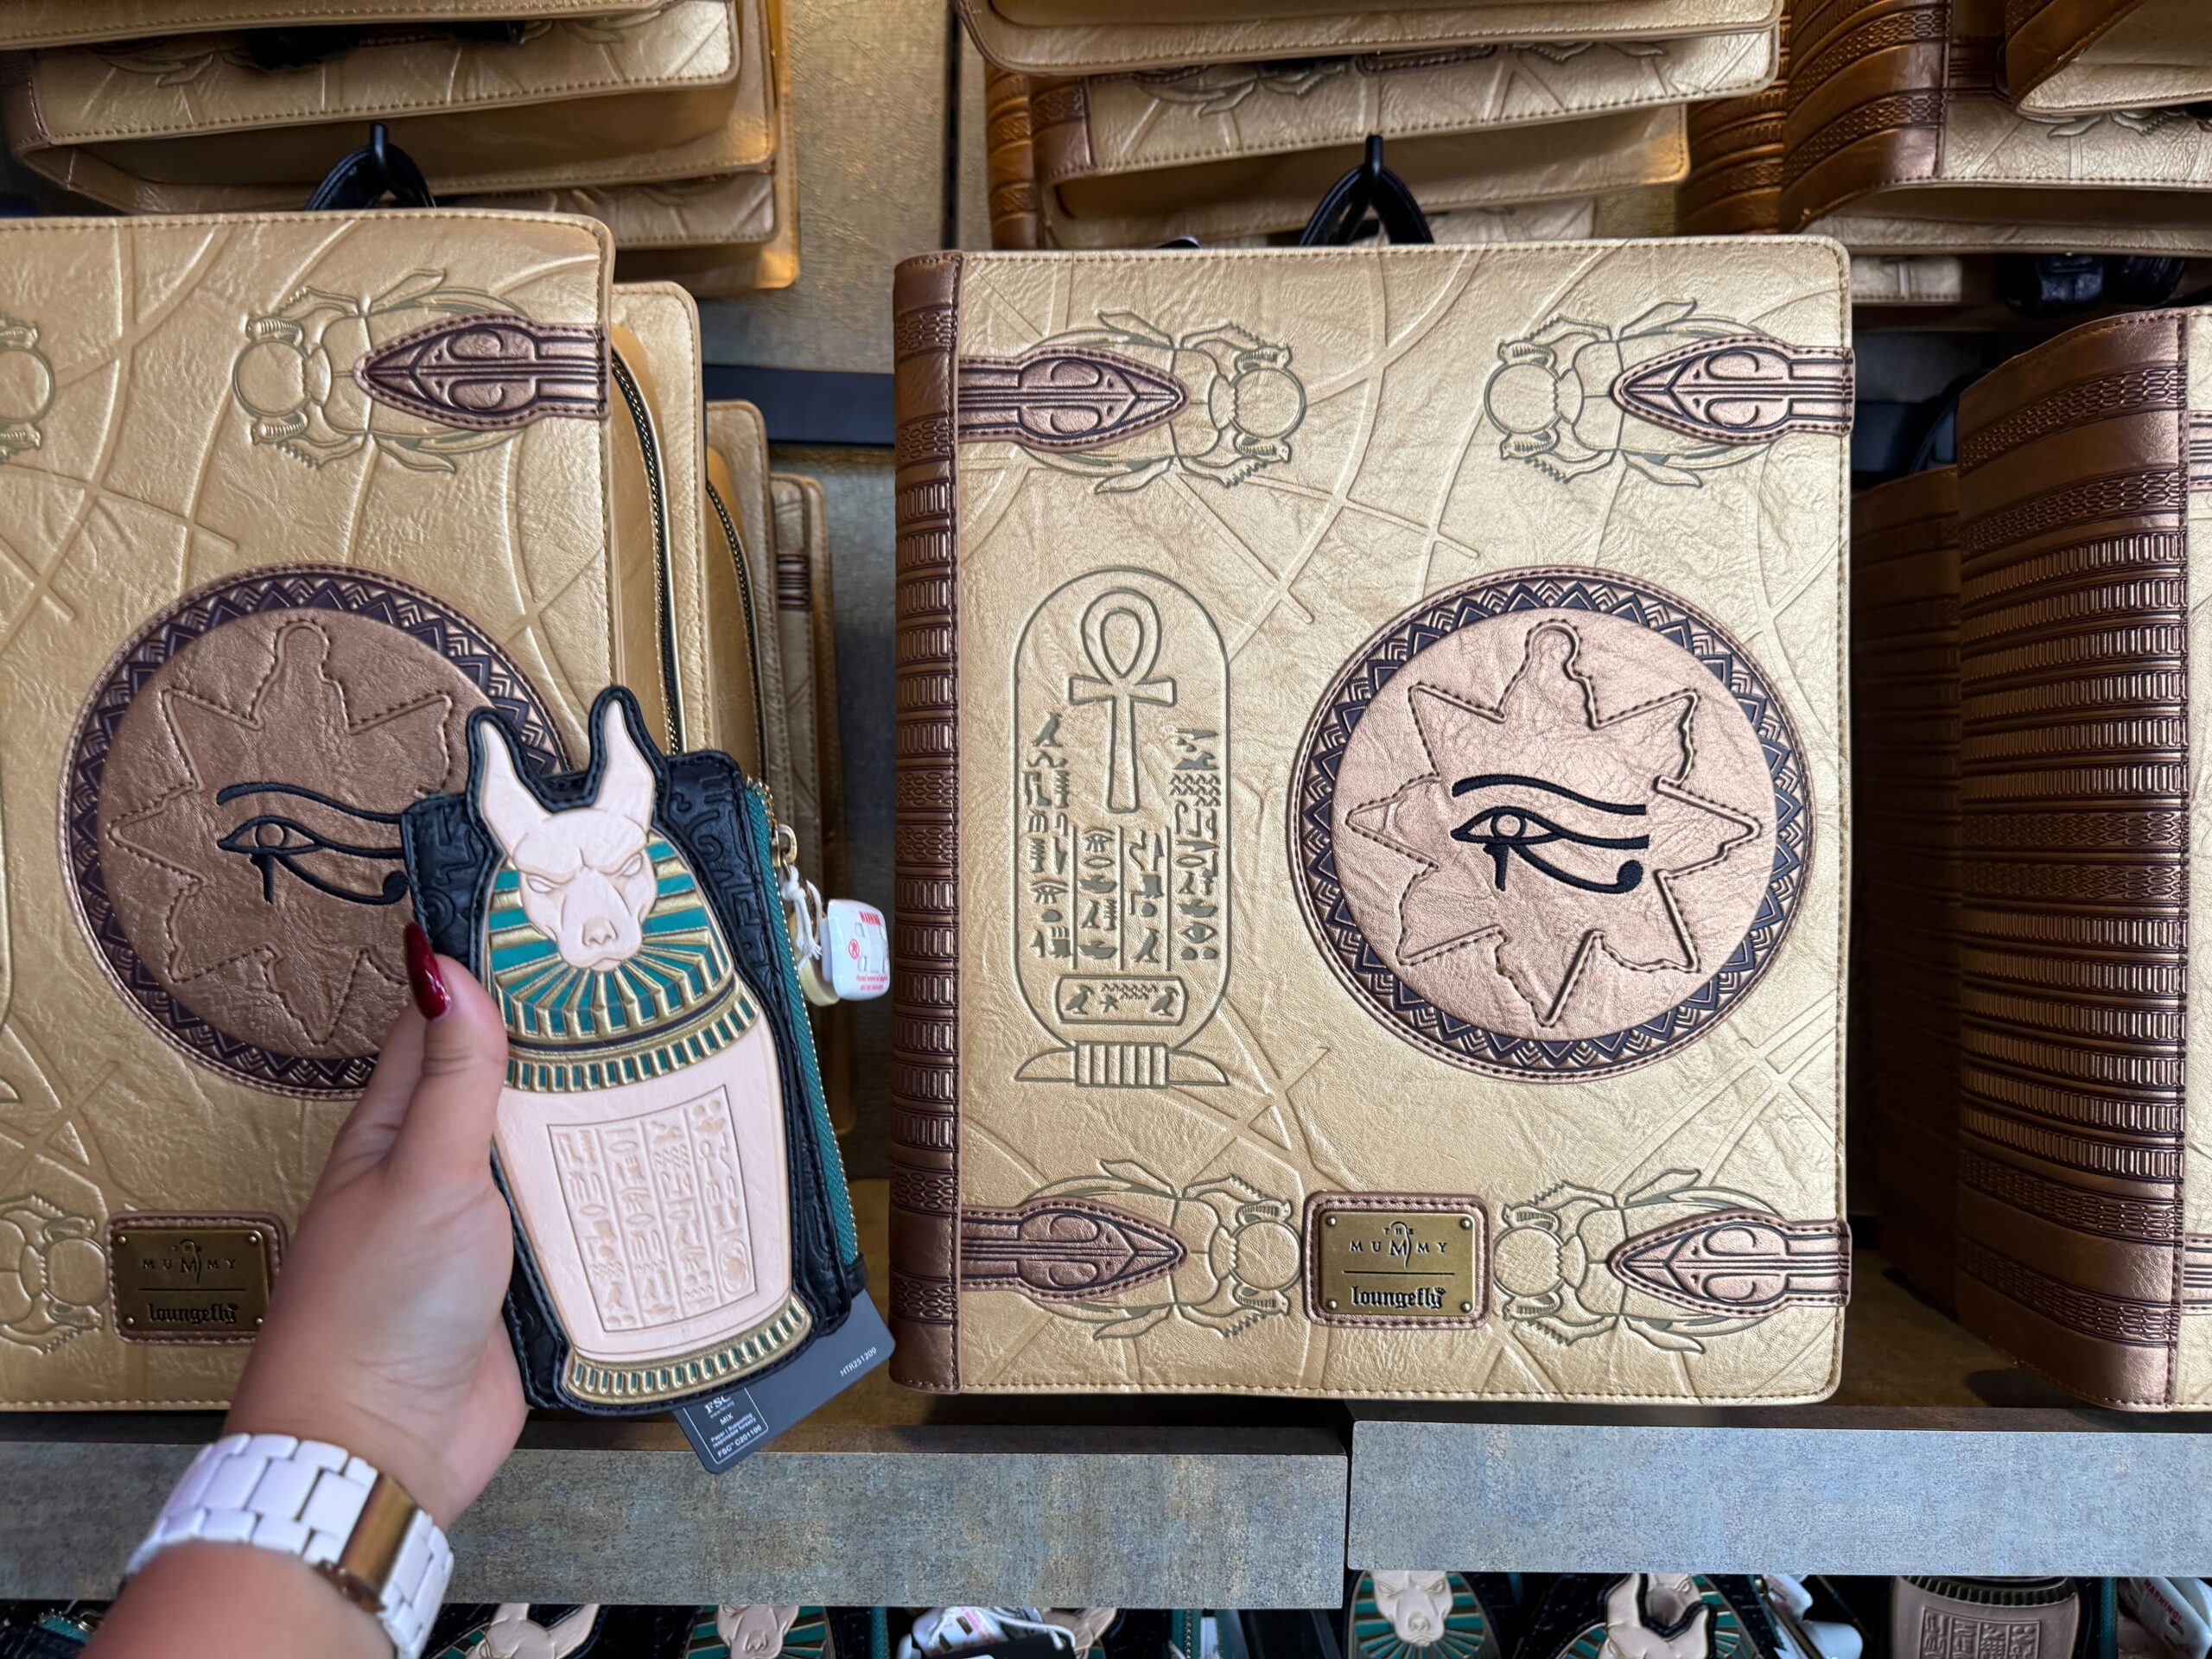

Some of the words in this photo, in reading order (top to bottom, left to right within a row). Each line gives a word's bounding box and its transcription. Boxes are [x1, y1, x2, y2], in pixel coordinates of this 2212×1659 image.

[1383, 1227, 1414, 1236] THE
[1350, 1240, 1447, 1256] MUMMY
[142, 1258, 236, 1274] MUMMY
[1351, 1286, 1445, 1310] loungefly
[148, 1303, 238, 1325] loungefly
[719, 1412, 734, 1426] MIX
[2144, 1578, 2183, 1624] WARNING!
